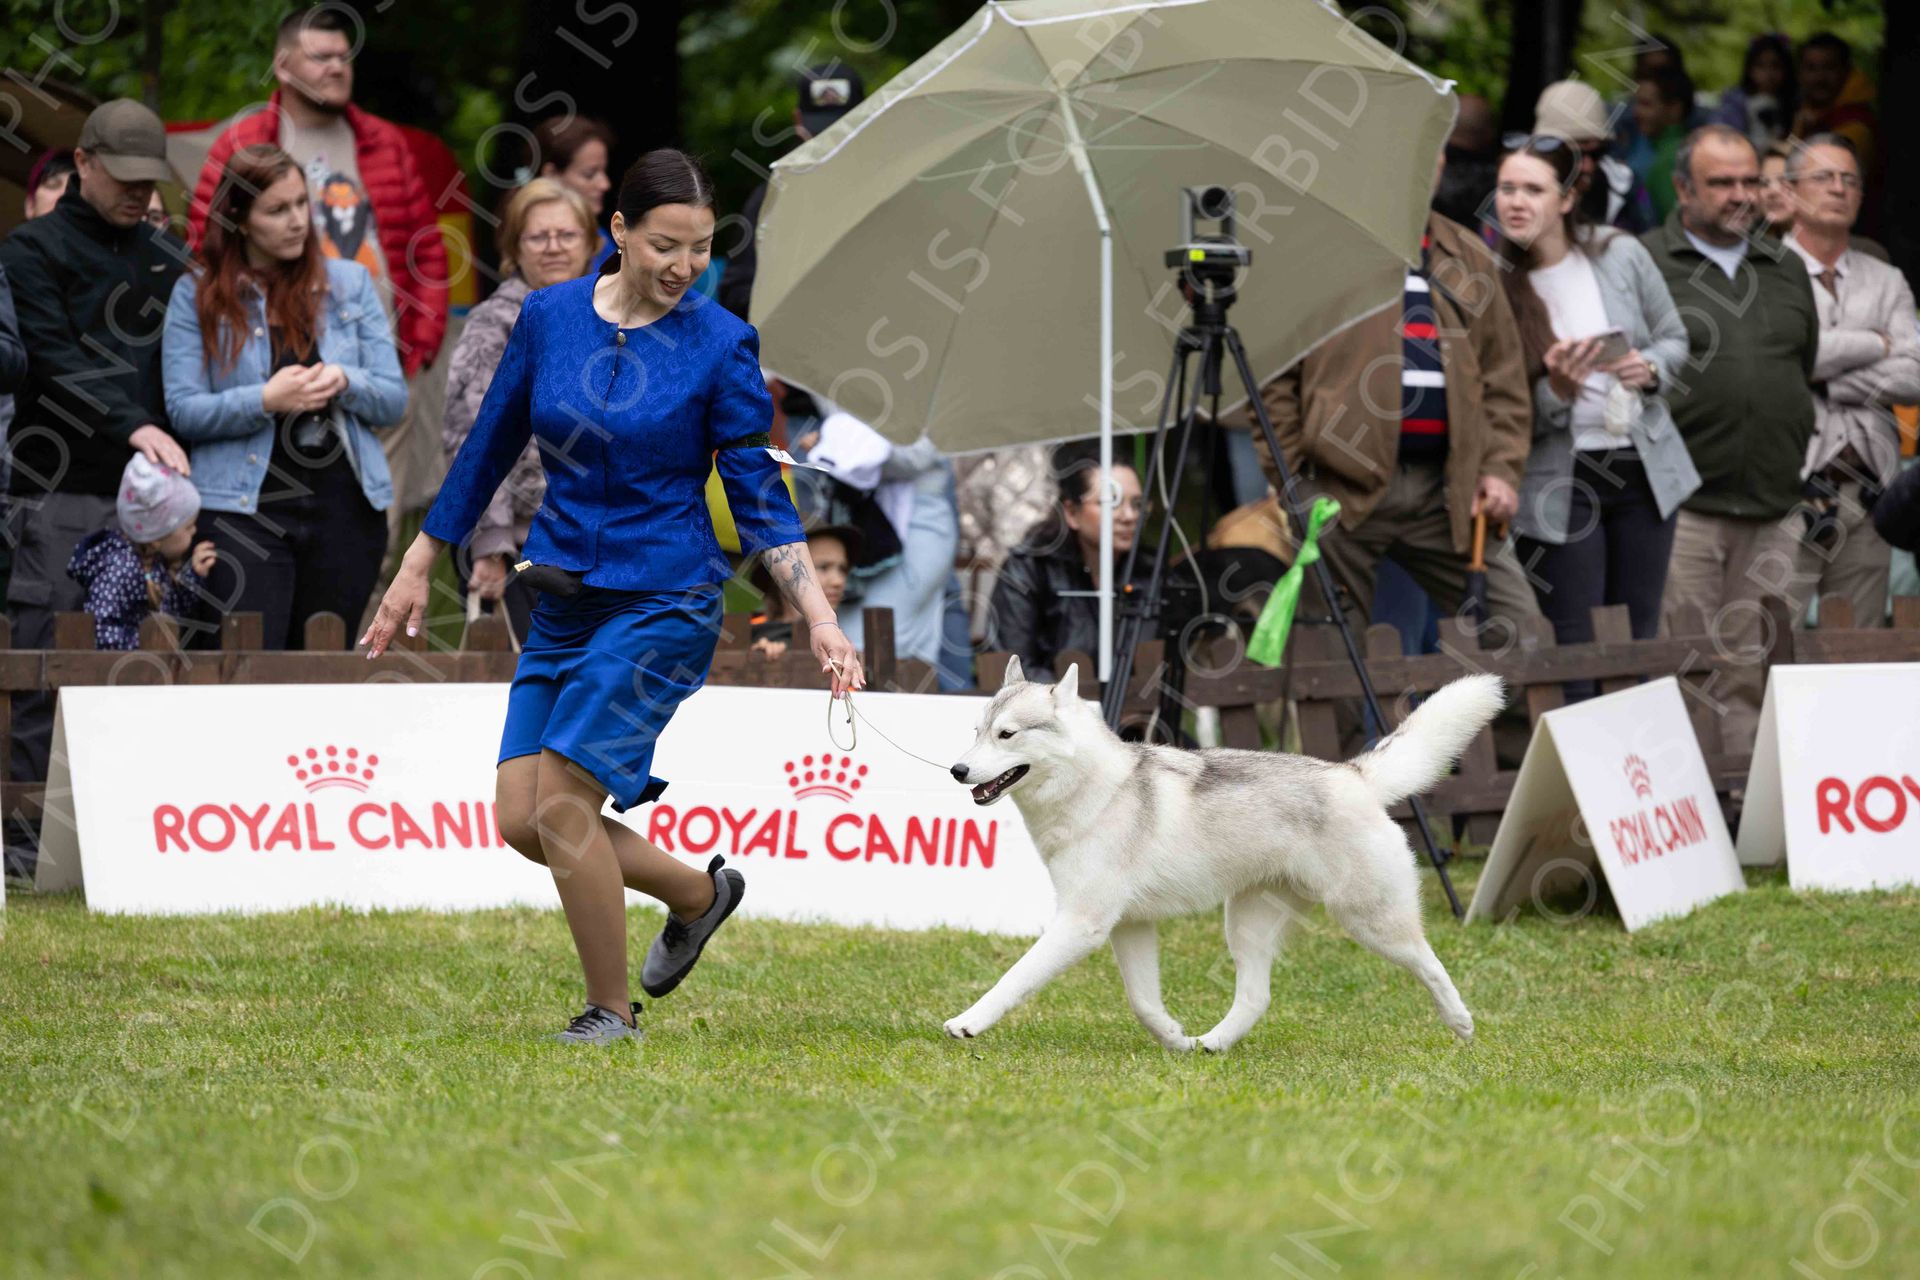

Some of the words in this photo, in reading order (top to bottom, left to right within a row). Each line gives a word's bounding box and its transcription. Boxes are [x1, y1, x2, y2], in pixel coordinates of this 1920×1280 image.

[152, 801, 336, 853] ROYAL
[1815, 774, 1920, 836] RO
[647, 803, 809, 860] ROYAL
[824, 812, 999, 870] CANIN
[1609, 809, 1662, 866] ROYAL
